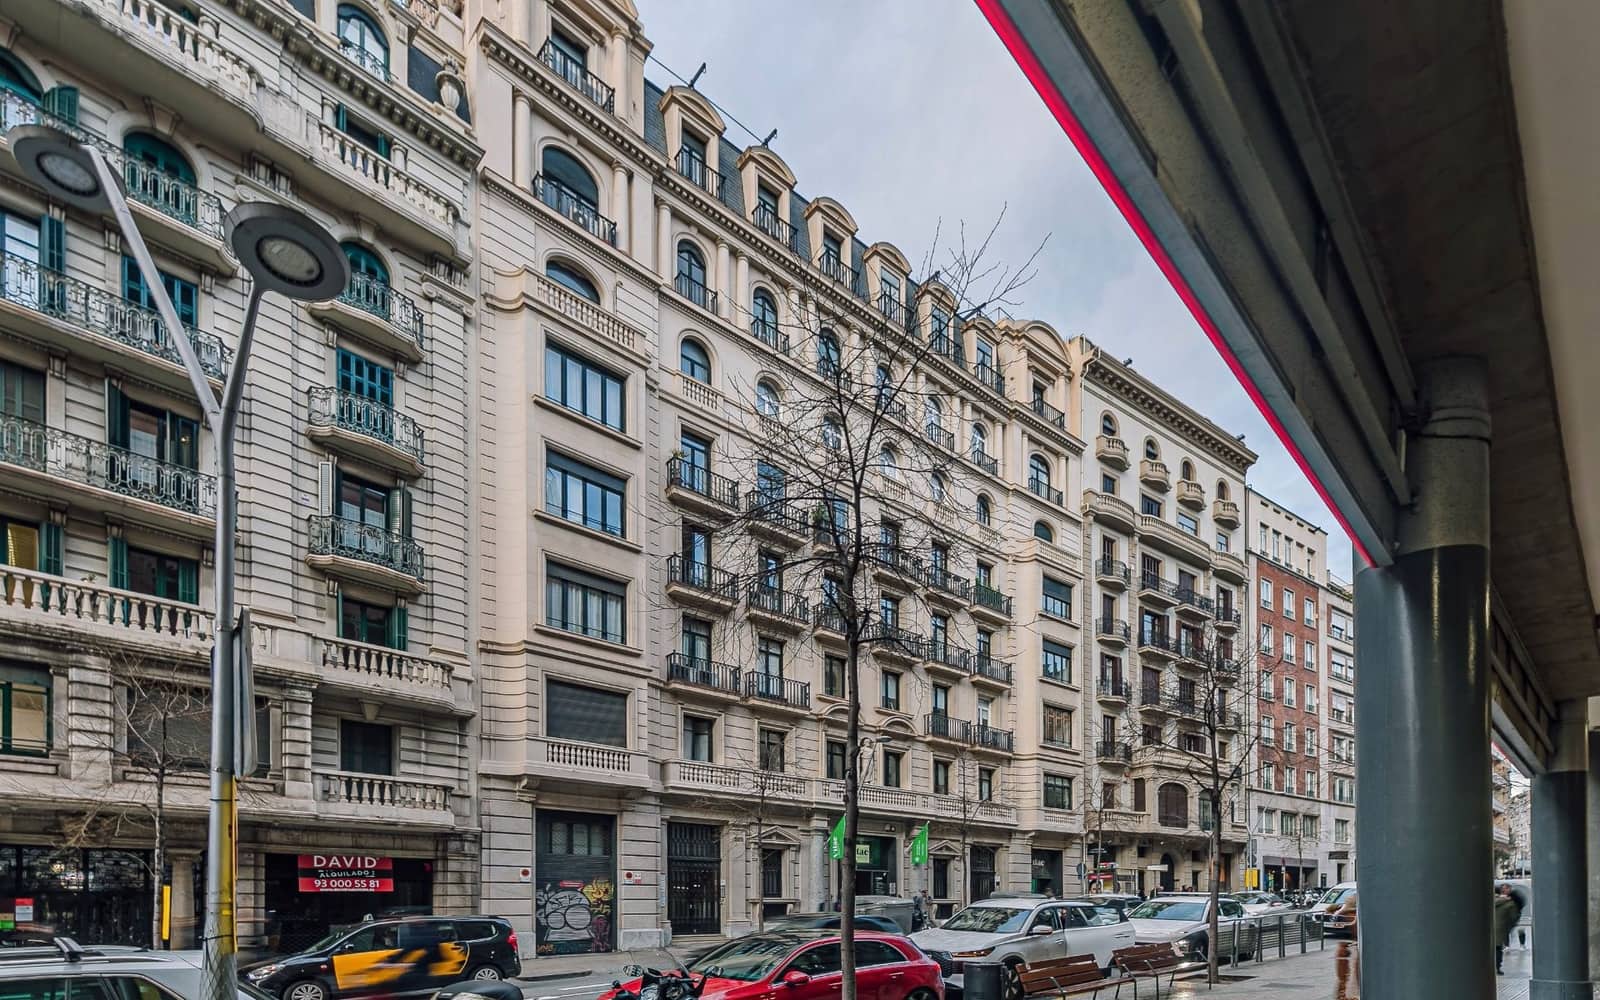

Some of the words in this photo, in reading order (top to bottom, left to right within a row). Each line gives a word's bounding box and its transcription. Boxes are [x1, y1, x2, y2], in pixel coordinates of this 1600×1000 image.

[313, 855, 377, 869] DAVID
[314, 879, 328, 888] 93
[330, 879, 352, 888] 000
[354, 879, 367, 888] 55
[369, 879, 380, 888] 81
